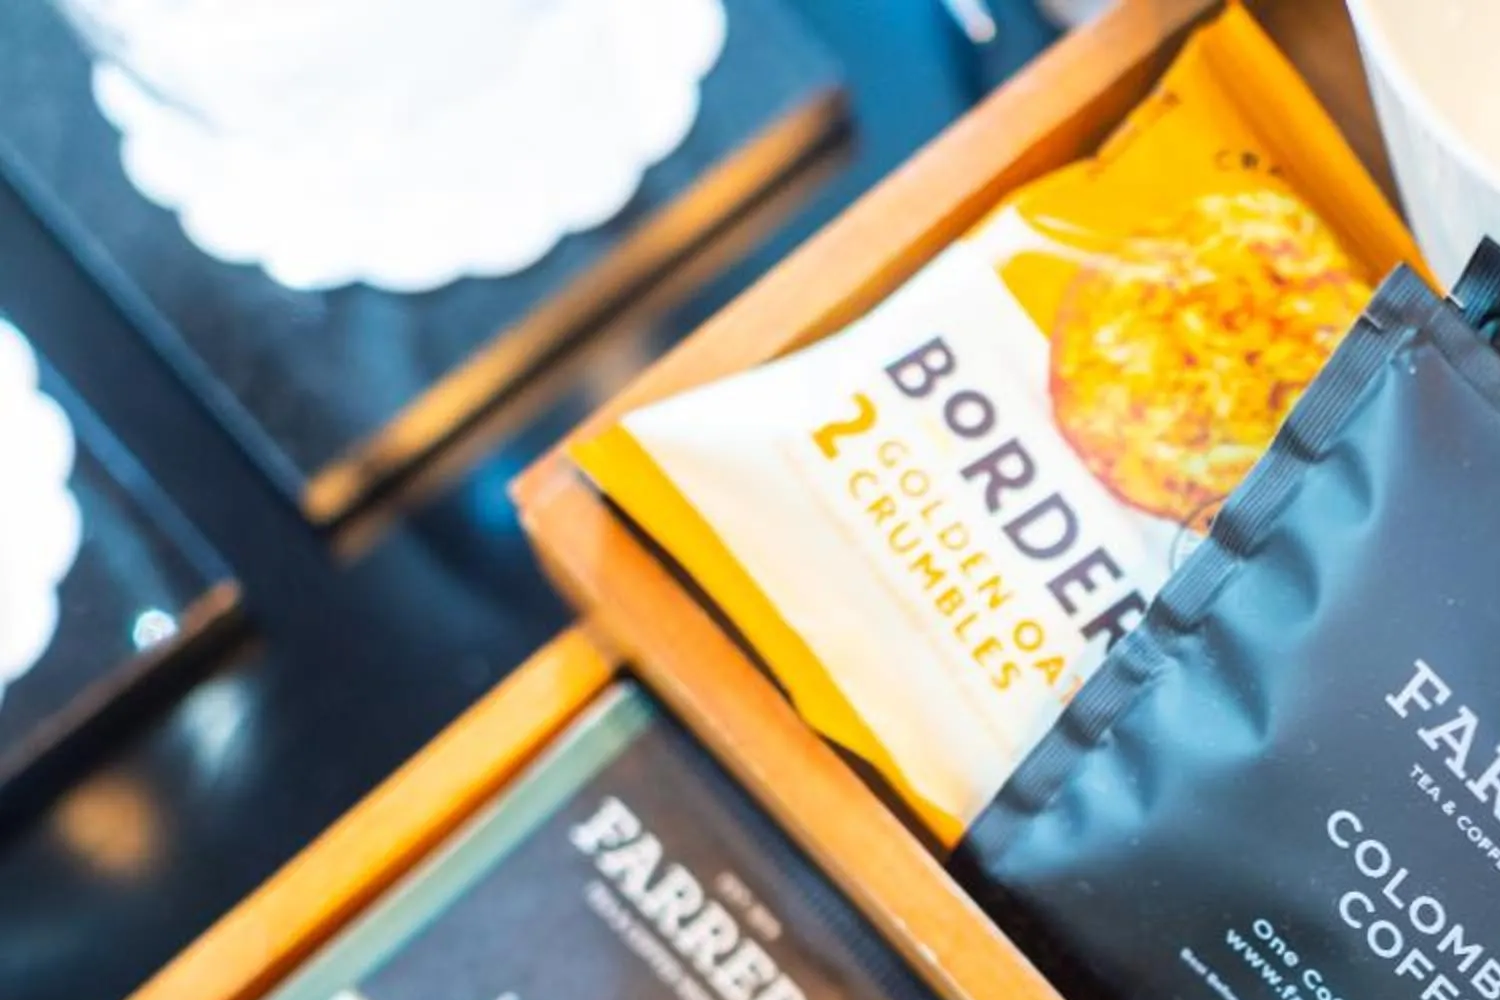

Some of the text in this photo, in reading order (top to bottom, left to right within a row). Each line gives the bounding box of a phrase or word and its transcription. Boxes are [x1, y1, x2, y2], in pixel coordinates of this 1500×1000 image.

[812, 393, 876, 460] 2
[877, 440, 1014, 609] GOLDEN
[884, 336, 1147, 655] BORDER
[849, 470, 1021, 690] CRUMBLES
[1409, 763, 1441, 803] TEA
[1441, 800, 1457, 816] &
[1252, 918, 1301, 968] One
